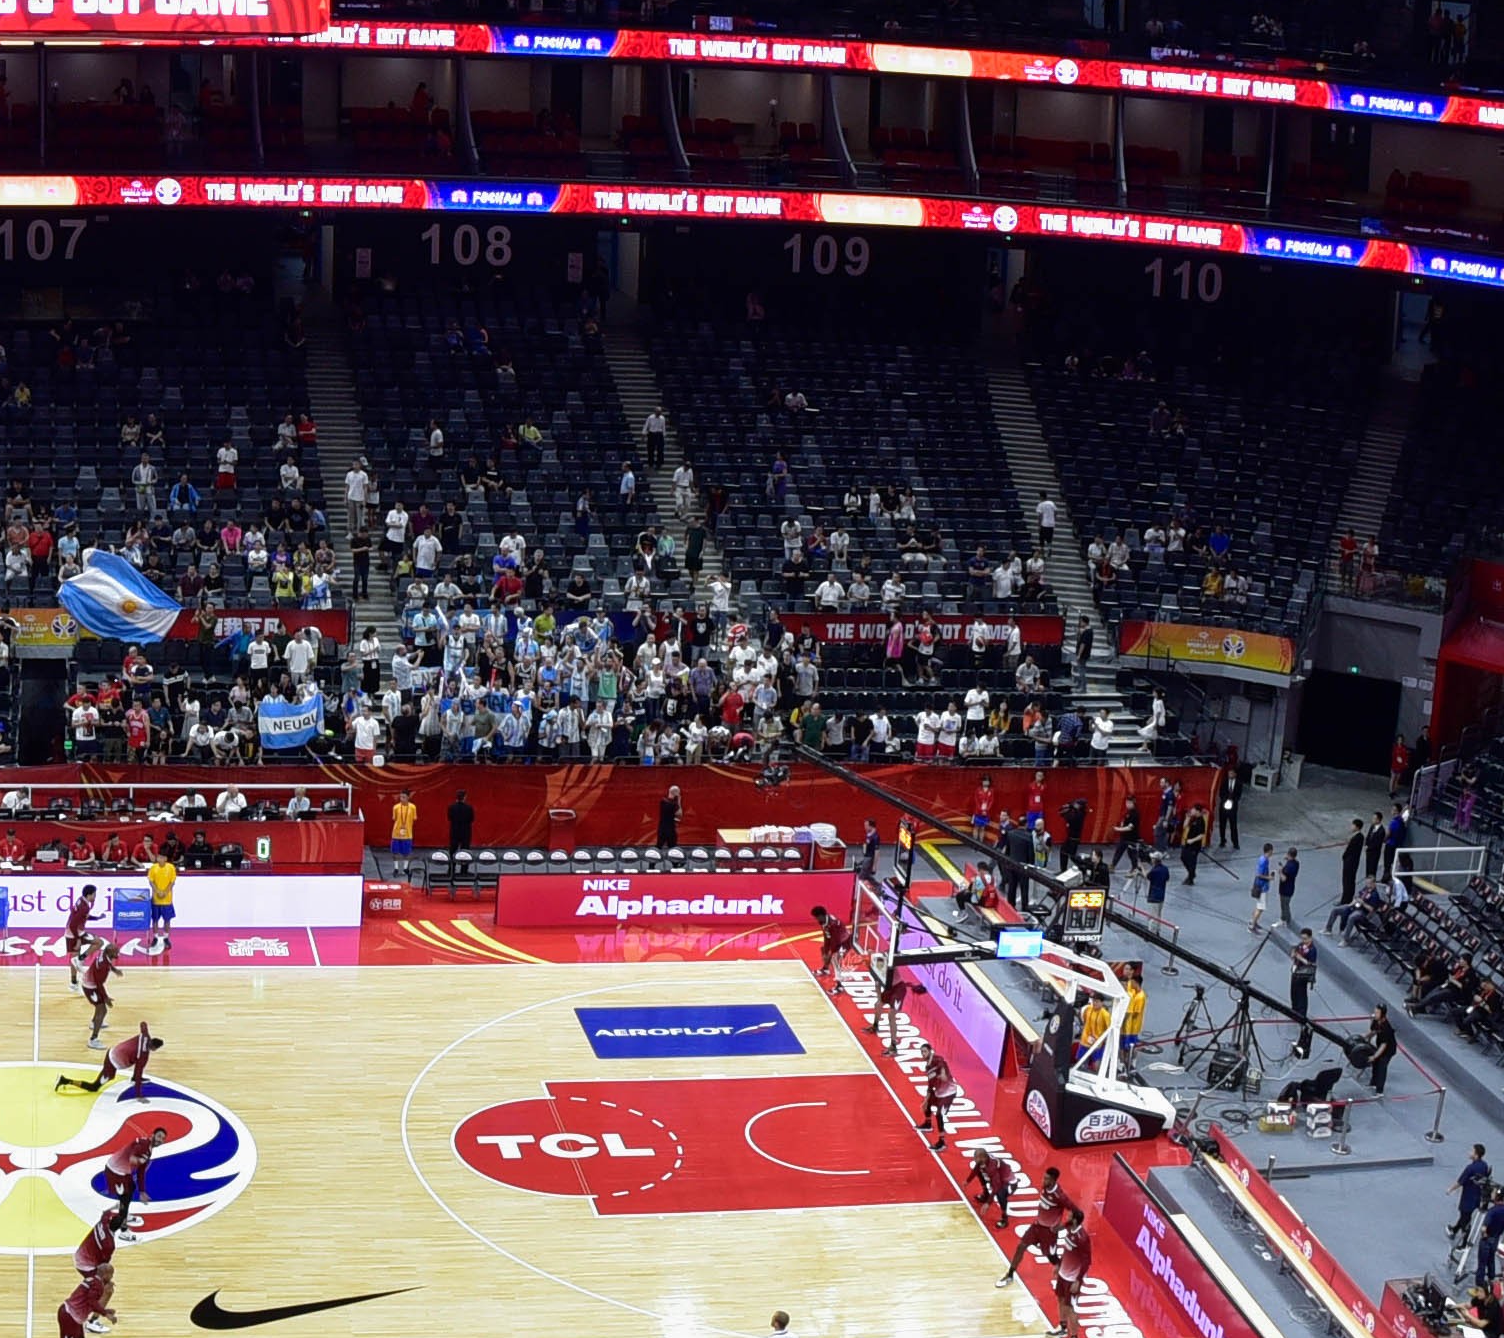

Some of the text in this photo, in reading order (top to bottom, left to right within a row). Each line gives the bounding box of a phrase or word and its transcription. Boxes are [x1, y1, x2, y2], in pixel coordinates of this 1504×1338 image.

[206, 183, 235, 201] THE
[241, 180, 314, 202] WORLD'S
[356, 184, 403, 203] GAME
[422, 223, 511, 266] 108
[784, 233, 869, 276] 109
[1145, 258, 1222, 302] 110
[583, 879, 631, 891] NIKE
[576, 894, 784, 919] Alphadunk
[1073, 935, 1102, 943] TISSOT
[595, 1026, 735, 1038] AEROFLOT
[1089, 1114, 1128, 1127] 百岁山
[476, 1132, 656, 1159] TCL
[1144, 1203, 1166, 1239] NIKE
